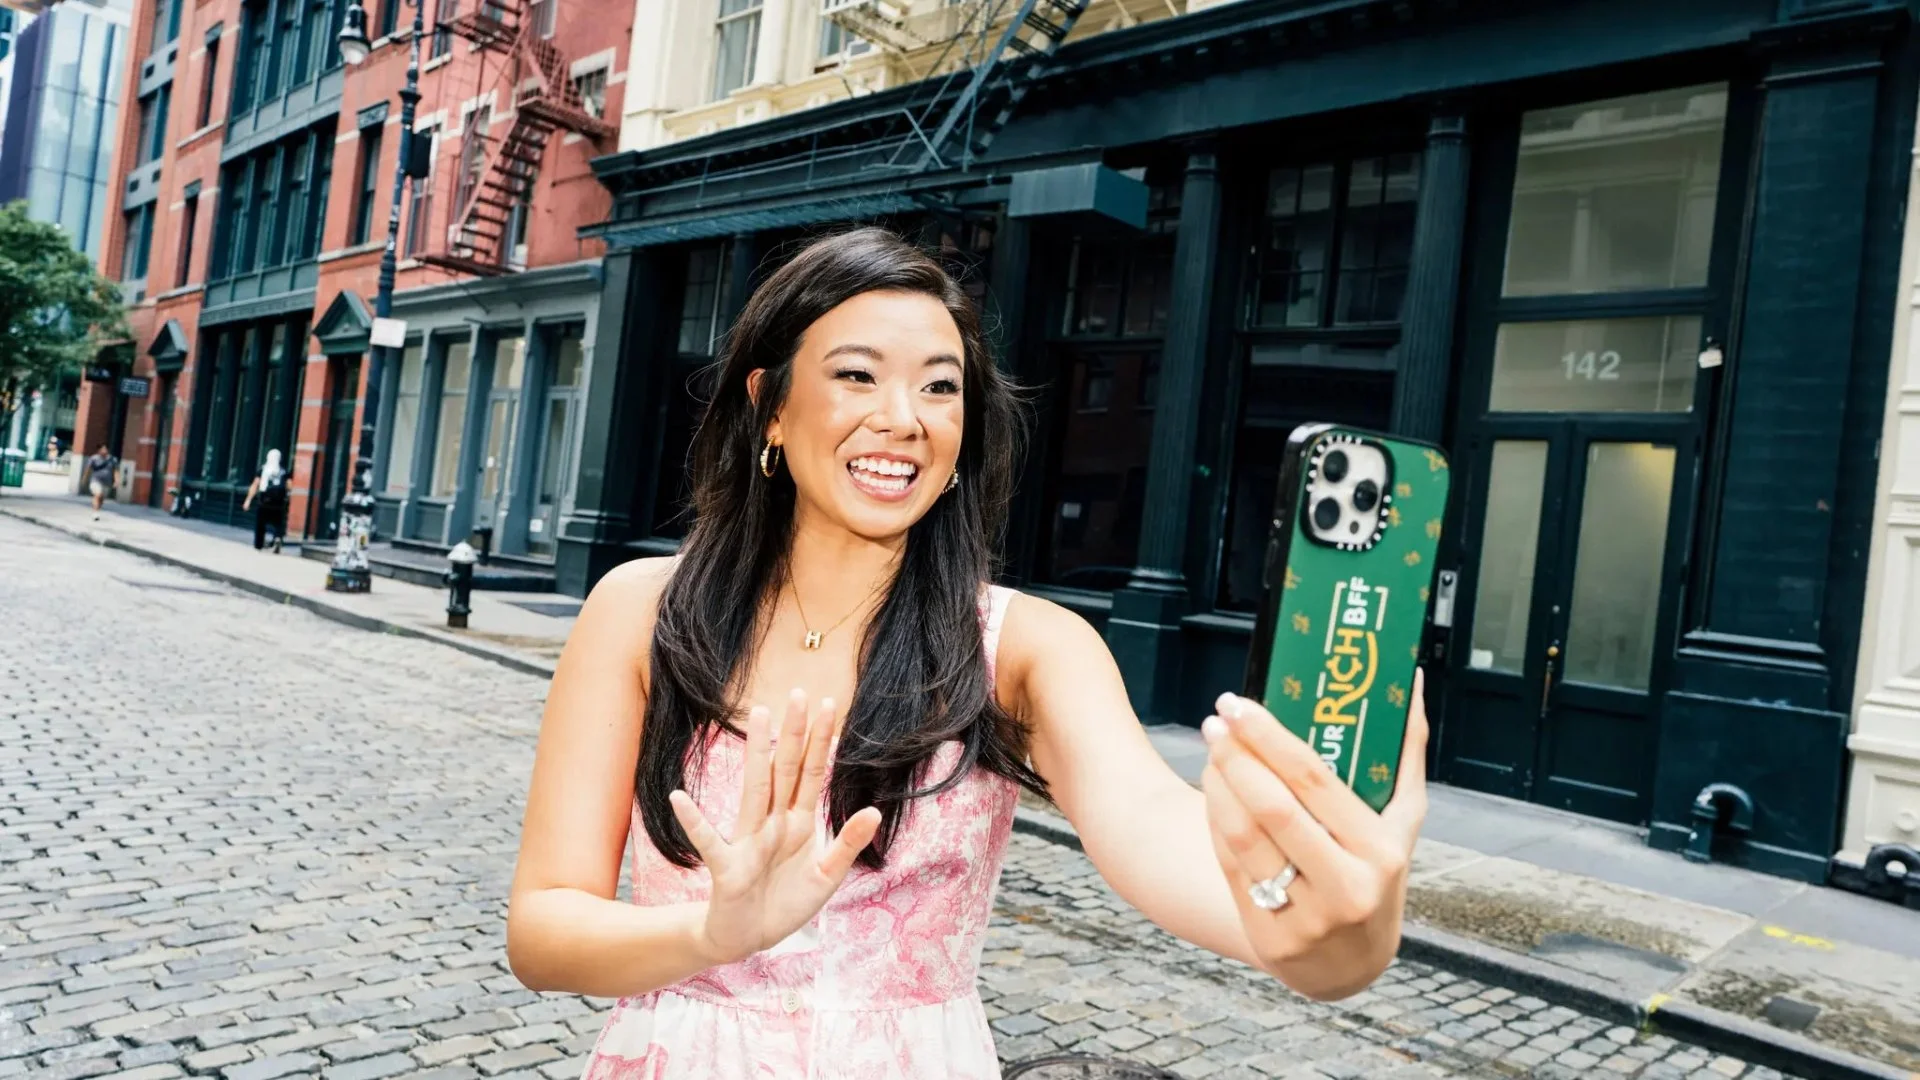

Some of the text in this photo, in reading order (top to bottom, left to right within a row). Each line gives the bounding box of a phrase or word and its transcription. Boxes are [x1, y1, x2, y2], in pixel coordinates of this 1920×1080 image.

[1561, 350, 1621, 380] 142
[1342, 576, 1371, 626] BFF
[1313, 627, 1378, 725] RICH
